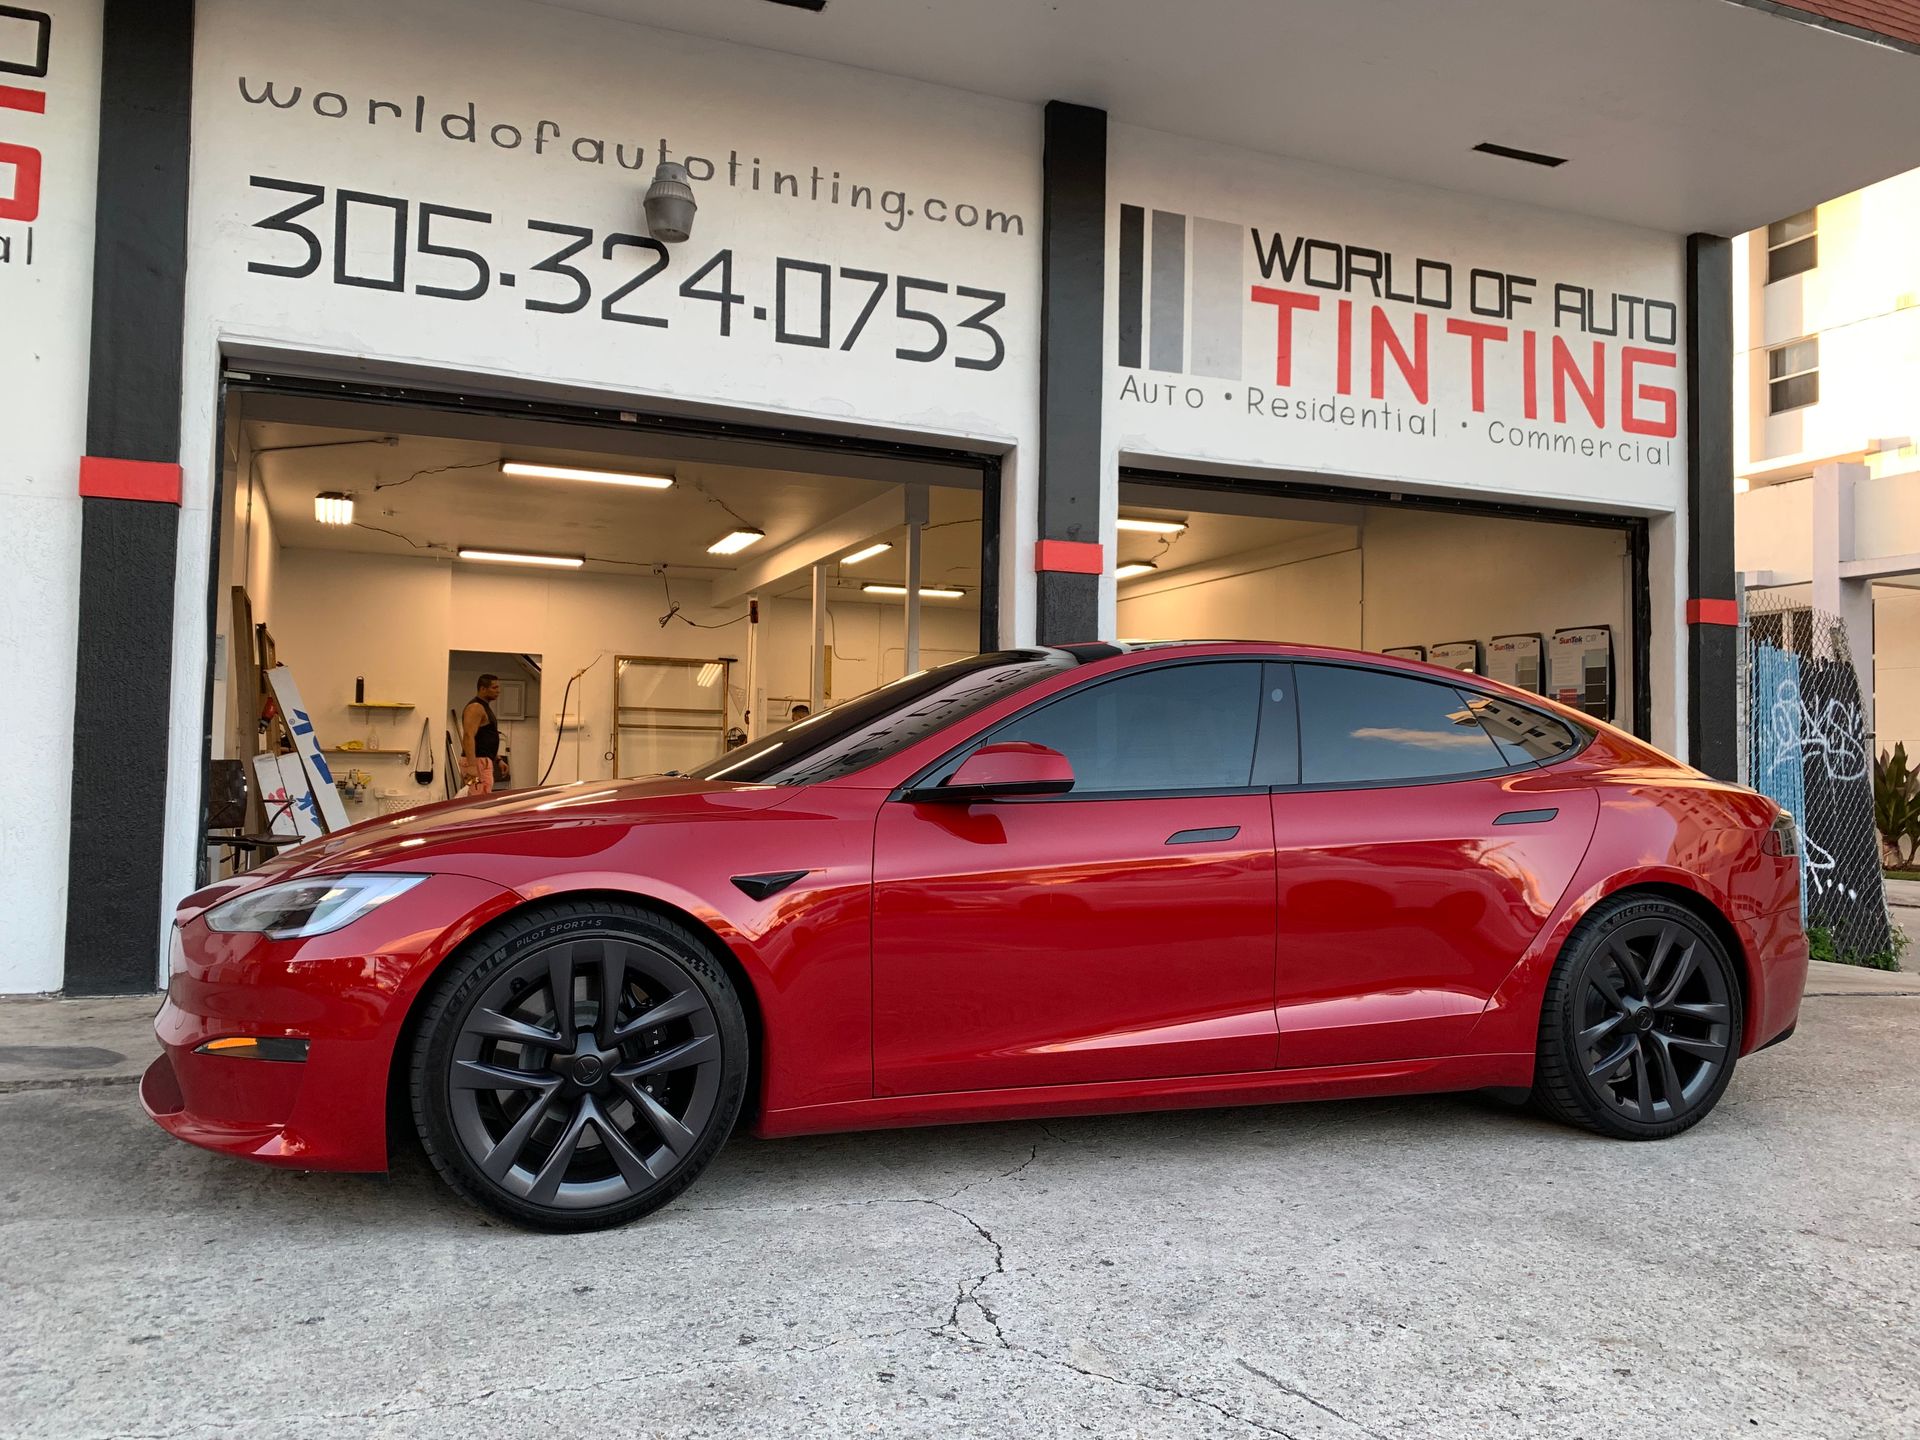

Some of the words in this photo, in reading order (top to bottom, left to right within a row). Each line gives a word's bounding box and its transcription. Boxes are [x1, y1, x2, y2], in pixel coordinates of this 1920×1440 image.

[239, 77, 1023, 236] worldofautotinting.com
[248, 176, 1006, 371] 305.324.0753
[1251, 228, 1452, 310] WORLD
[1471, 269, 1536, 319] OF
[1555, 283, 1676, 345] AUTO
[1251, 286, 1676, 438] TINTING
[1248, 387, 1437, 437] Residential
[1488, 421, 1670, 466] Commercial
[1494, 643, 1515, 651] SunTek
[1559, 636, 1583, 645] SunTek
[516, 929, 547, 948] PILOT
